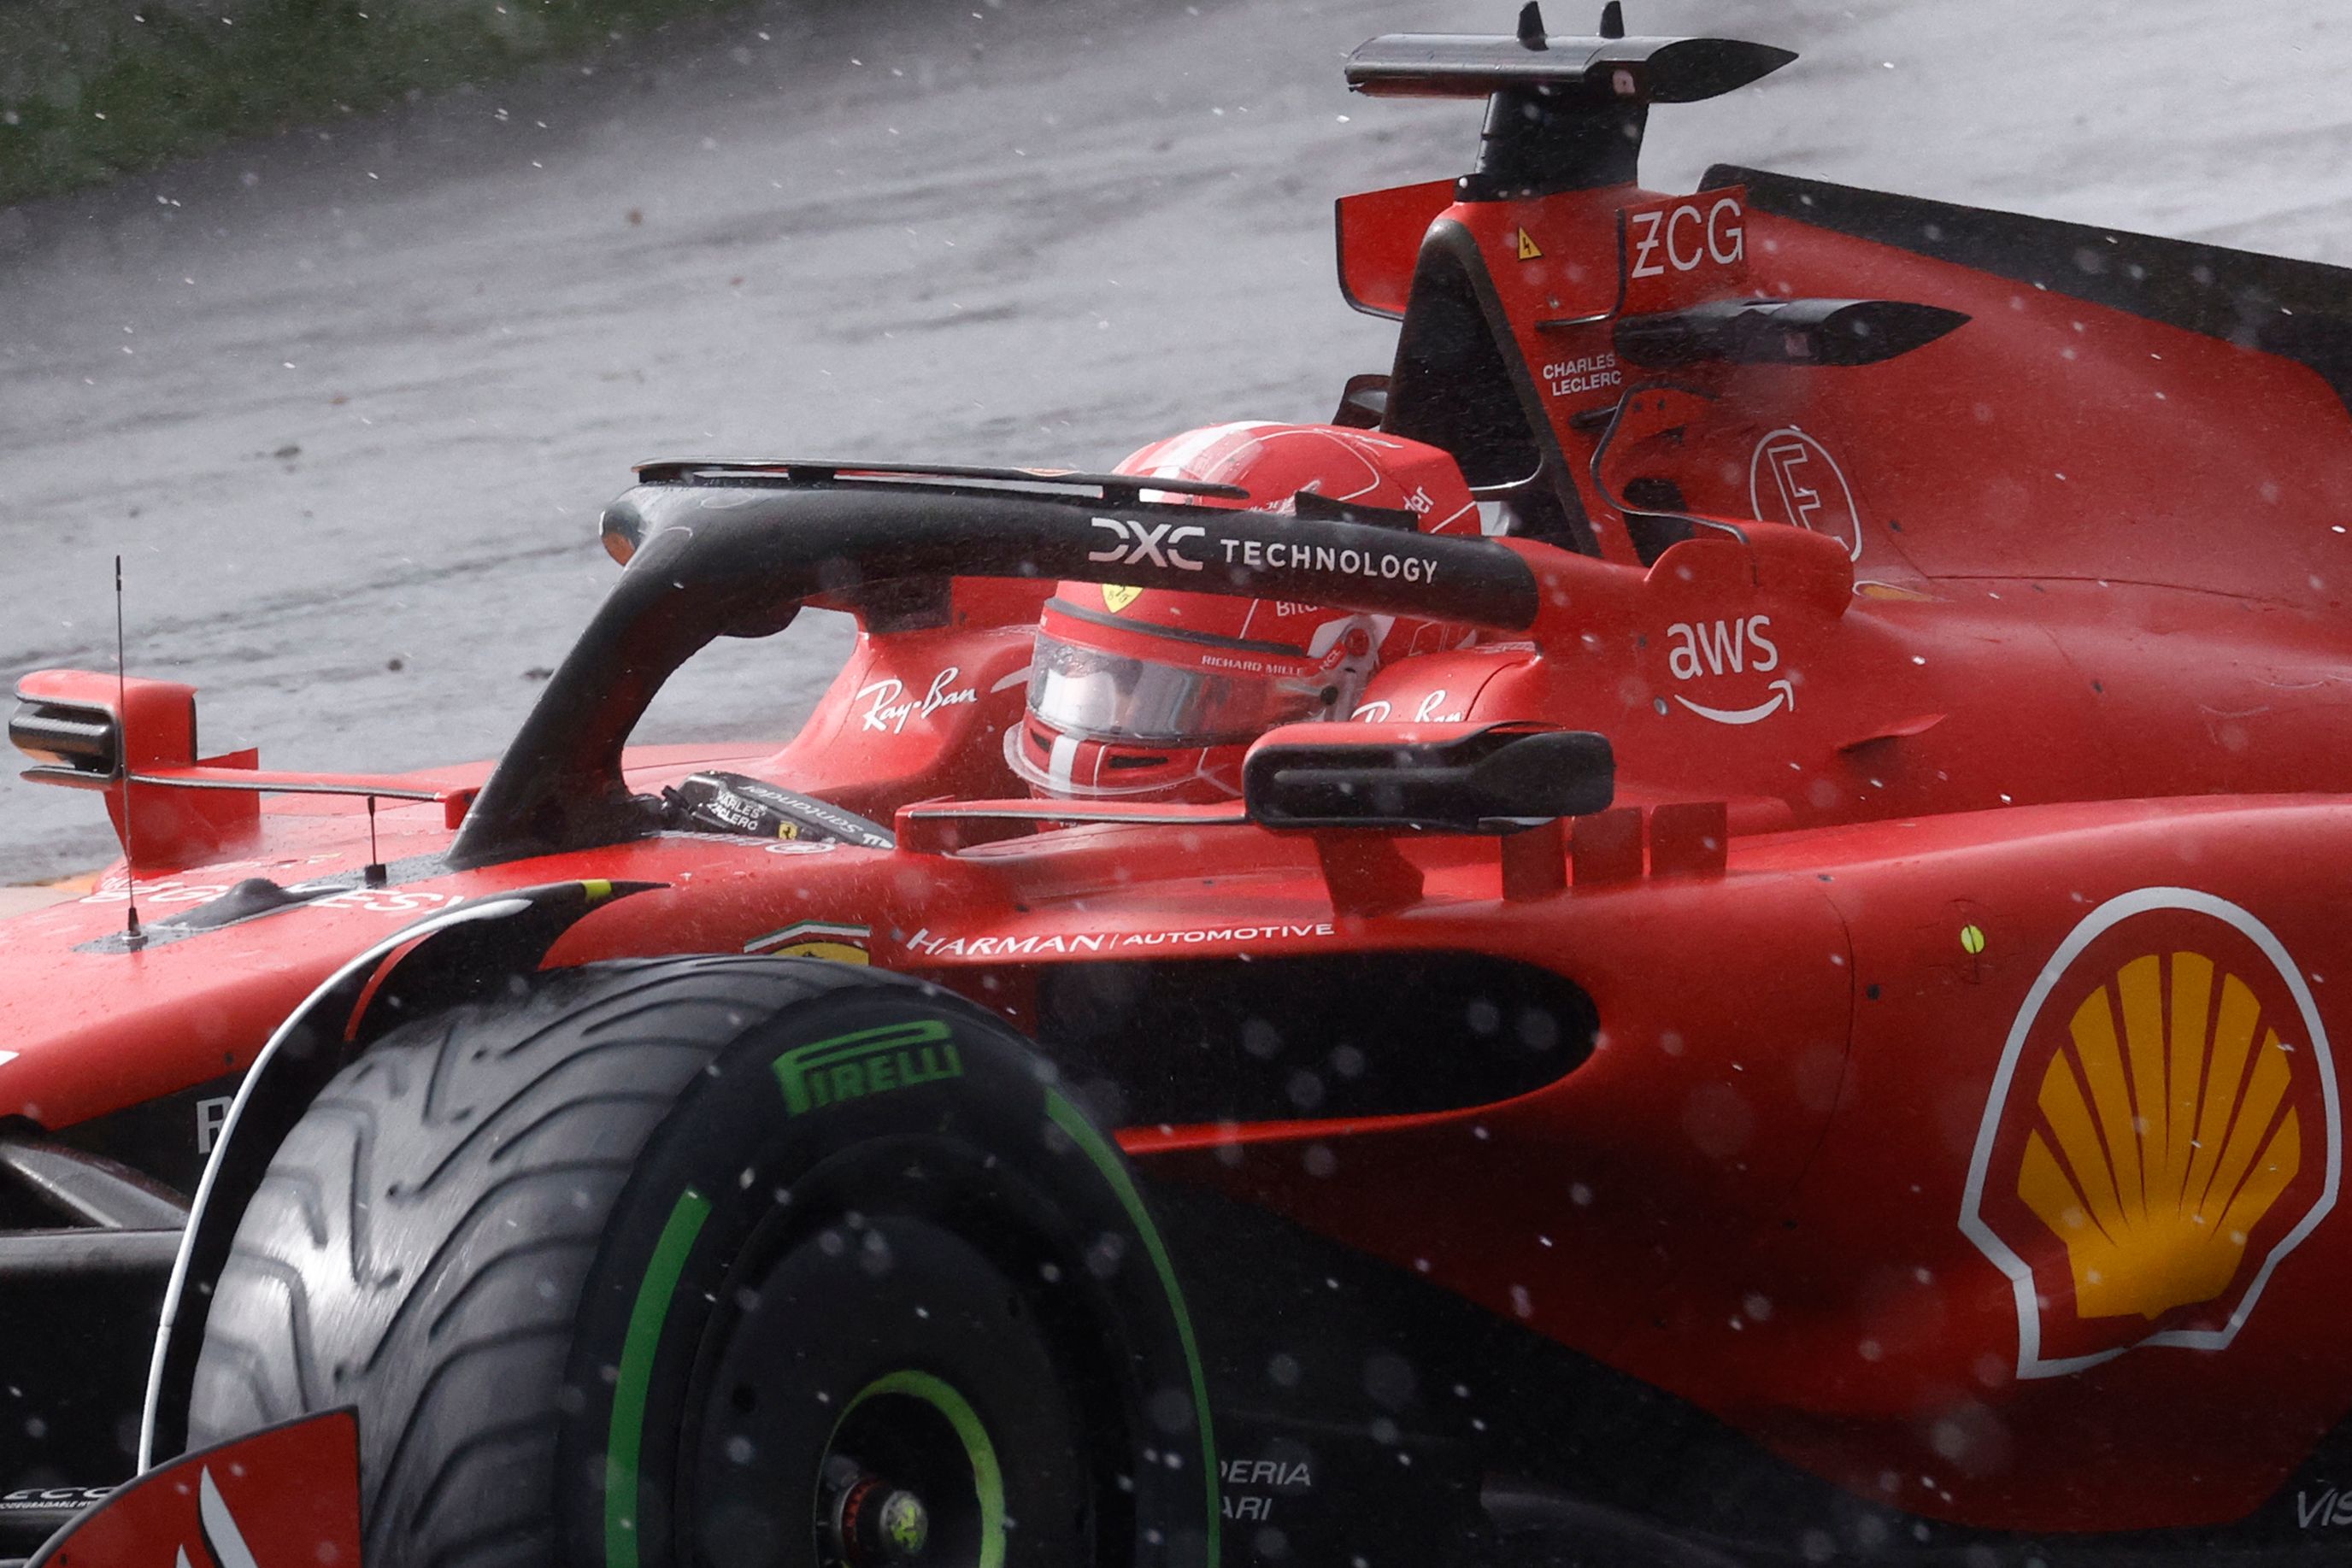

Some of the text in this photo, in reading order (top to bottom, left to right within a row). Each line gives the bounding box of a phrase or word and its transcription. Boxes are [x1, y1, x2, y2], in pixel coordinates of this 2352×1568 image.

[1631, 197, 1743, 279] ZCG
[1543, 353, 1615, 379] CHARLES
[1551, 370, 1622, 396] LECLERC
[1088, 517, 1438, 584] DXC TECHNOLOGY
[1201, 655, 1263, 672] RICHARD
[1667, 614, 1779, 679] aws
[906, 923, 1336, 955] HARMAN AUTOMOTIVE
[773, 1019, 964, 1118] PIRELLI
